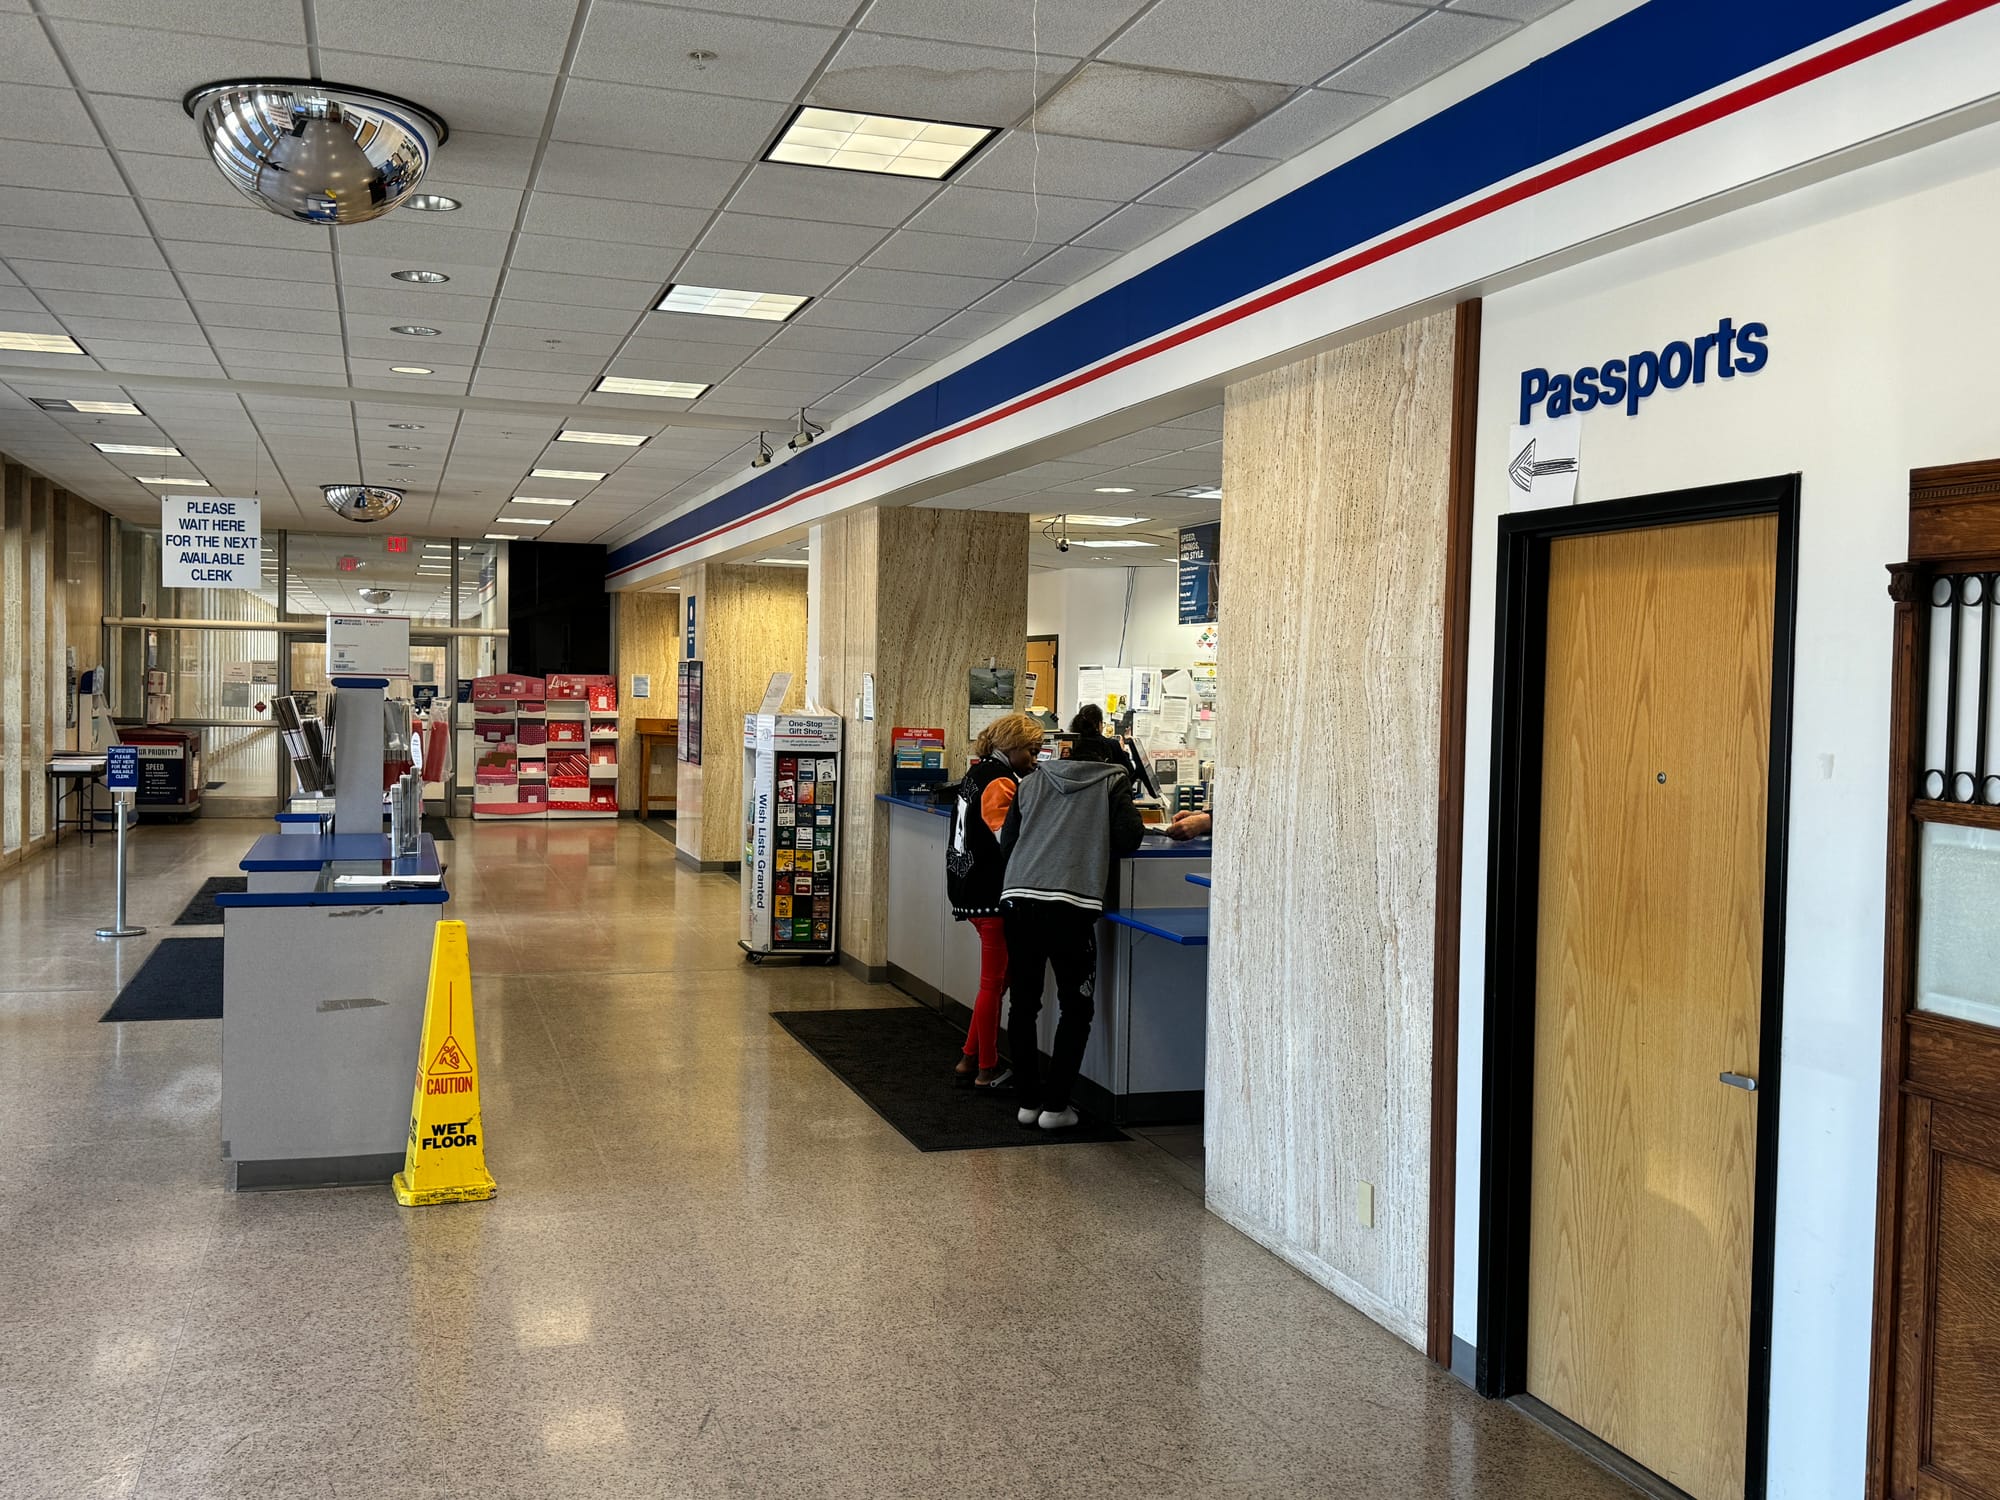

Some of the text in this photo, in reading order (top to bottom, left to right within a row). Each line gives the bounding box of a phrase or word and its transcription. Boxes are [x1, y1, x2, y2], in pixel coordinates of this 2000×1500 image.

[1519, 317, 1769, 426] Passports
[187, 502, 236, 515] PLEASE
[178, 518, 246, 532] WAIT HERE
[166, 534, 258, 549] FOR THE NEXT
[179, 552, 245, 565] AVAILABLE
[1190, 550, 1204, 559] STYLE
[191, 568, 233, 582] CLERK
[548, 675, 569, 690] Love
[788, 719, 823, 728] One-Stop
[788, 727, 823, 736] Gift Shop
[147, 748, 178, 756] PRIORITY?
[756, 793, 767, 909] Wish Lists Granted
[427, 1077, 472, 1095] CAUTION
[432, 1122, 468, 1136] WET
[422, 1135, 476, 1150] FLOOR
